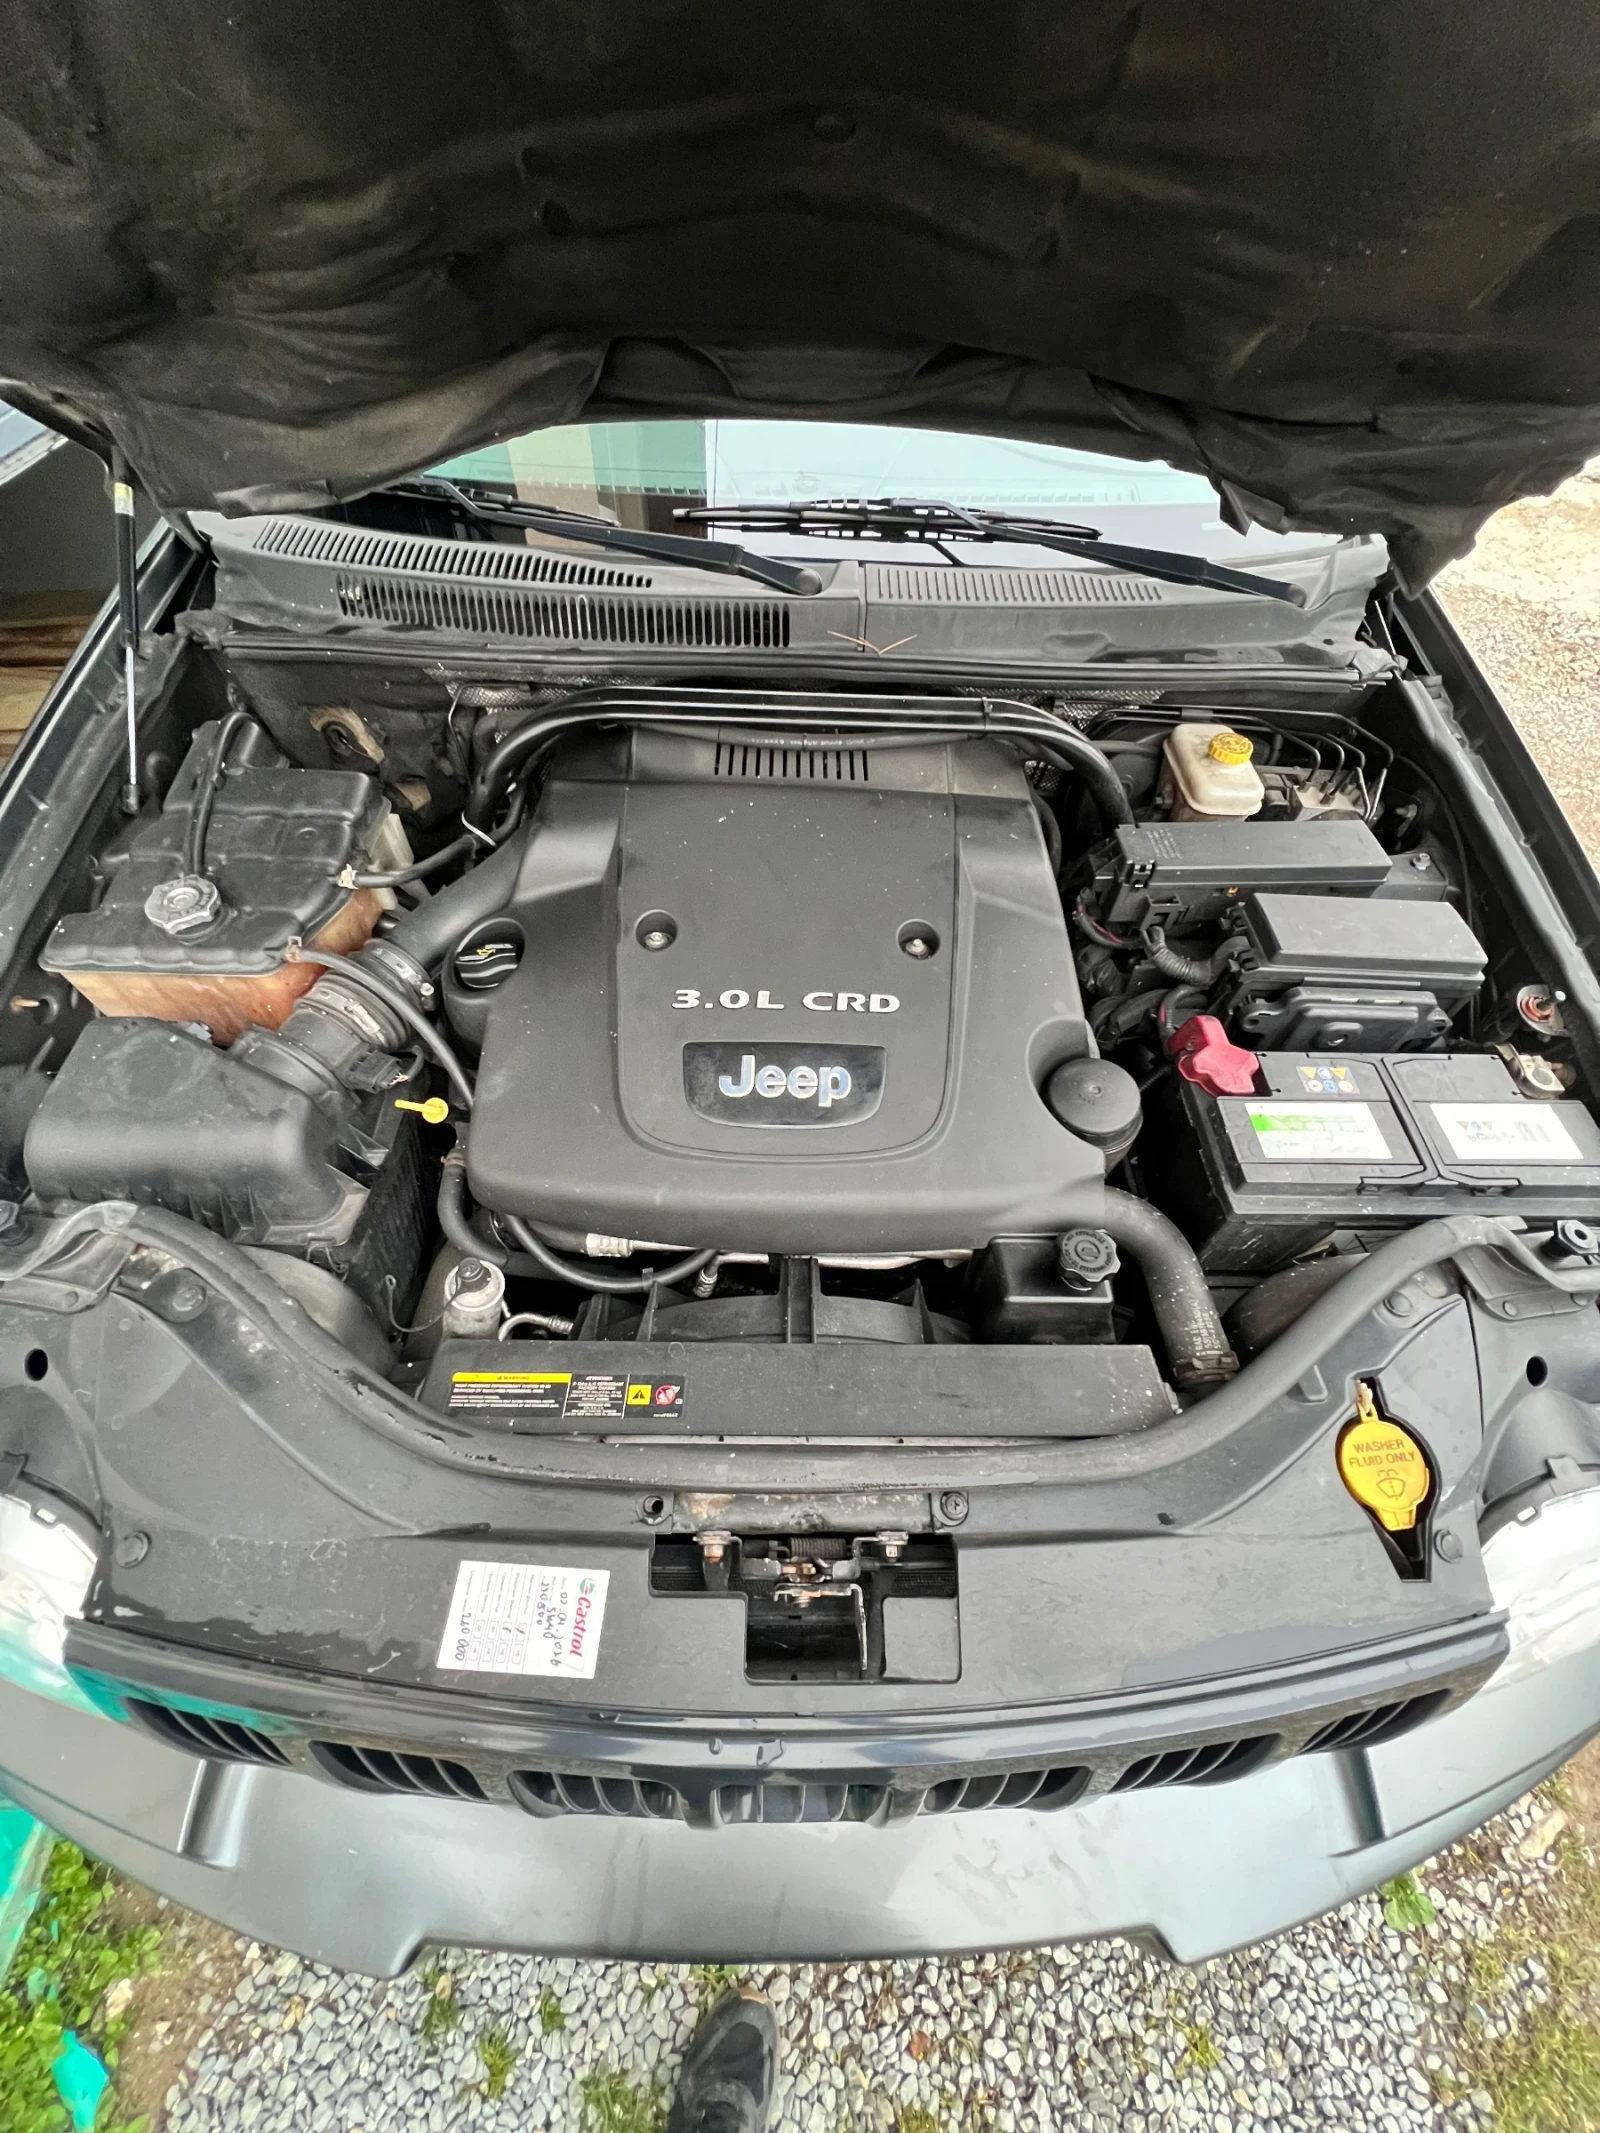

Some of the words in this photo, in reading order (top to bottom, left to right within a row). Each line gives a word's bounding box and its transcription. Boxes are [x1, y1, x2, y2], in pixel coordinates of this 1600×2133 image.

[671, 989, 785, 1010] 3.0L
[802, 991, 901, 1013] CRD
[718, 1054, 852, 1107] Jeep
[1352, 1438, 1406, 1454] WASHER
[1348, 1454, 1384, 1468] FLUID
[1386, 1451, 1416, 1464] ONLY
[569, 1596, 592, 1658] Castrol
